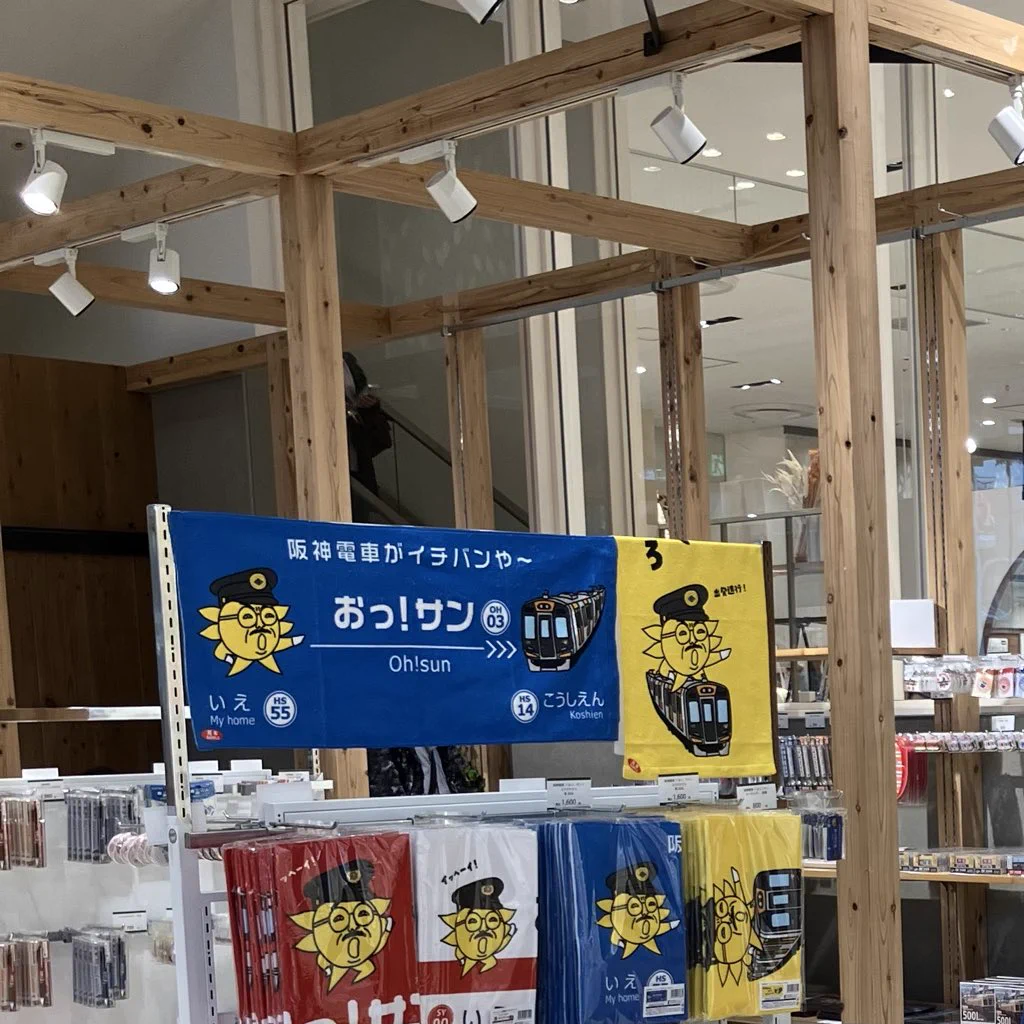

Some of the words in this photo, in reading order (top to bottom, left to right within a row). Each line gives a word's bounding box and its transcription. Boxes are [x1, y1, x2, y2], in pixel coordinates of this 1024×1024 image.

[334, 595, 474, 632] おっ!サン
[489, 606, 502, 614] OH
[487, 614, 505, 629] 03
[389, 654, 451, 673] Oh!sun
[209, 693, 251, 712] いえ
[520, 695, 531, 703] HS
[543, 691, 605, 708] こうしえん
[271, 706, 291, 720] 55
[518, 703, 534, 717] 14
[569, 710, 604, 720] Koshien
[210, 715, 224, 727] My
[227, 715, 255, 726] home
[605, 973, 637, 991] いえ
[605, 995, 616, 1005] My
[618, 994, 640, 1003] home
[436, 1009, 446, 1017] SY
